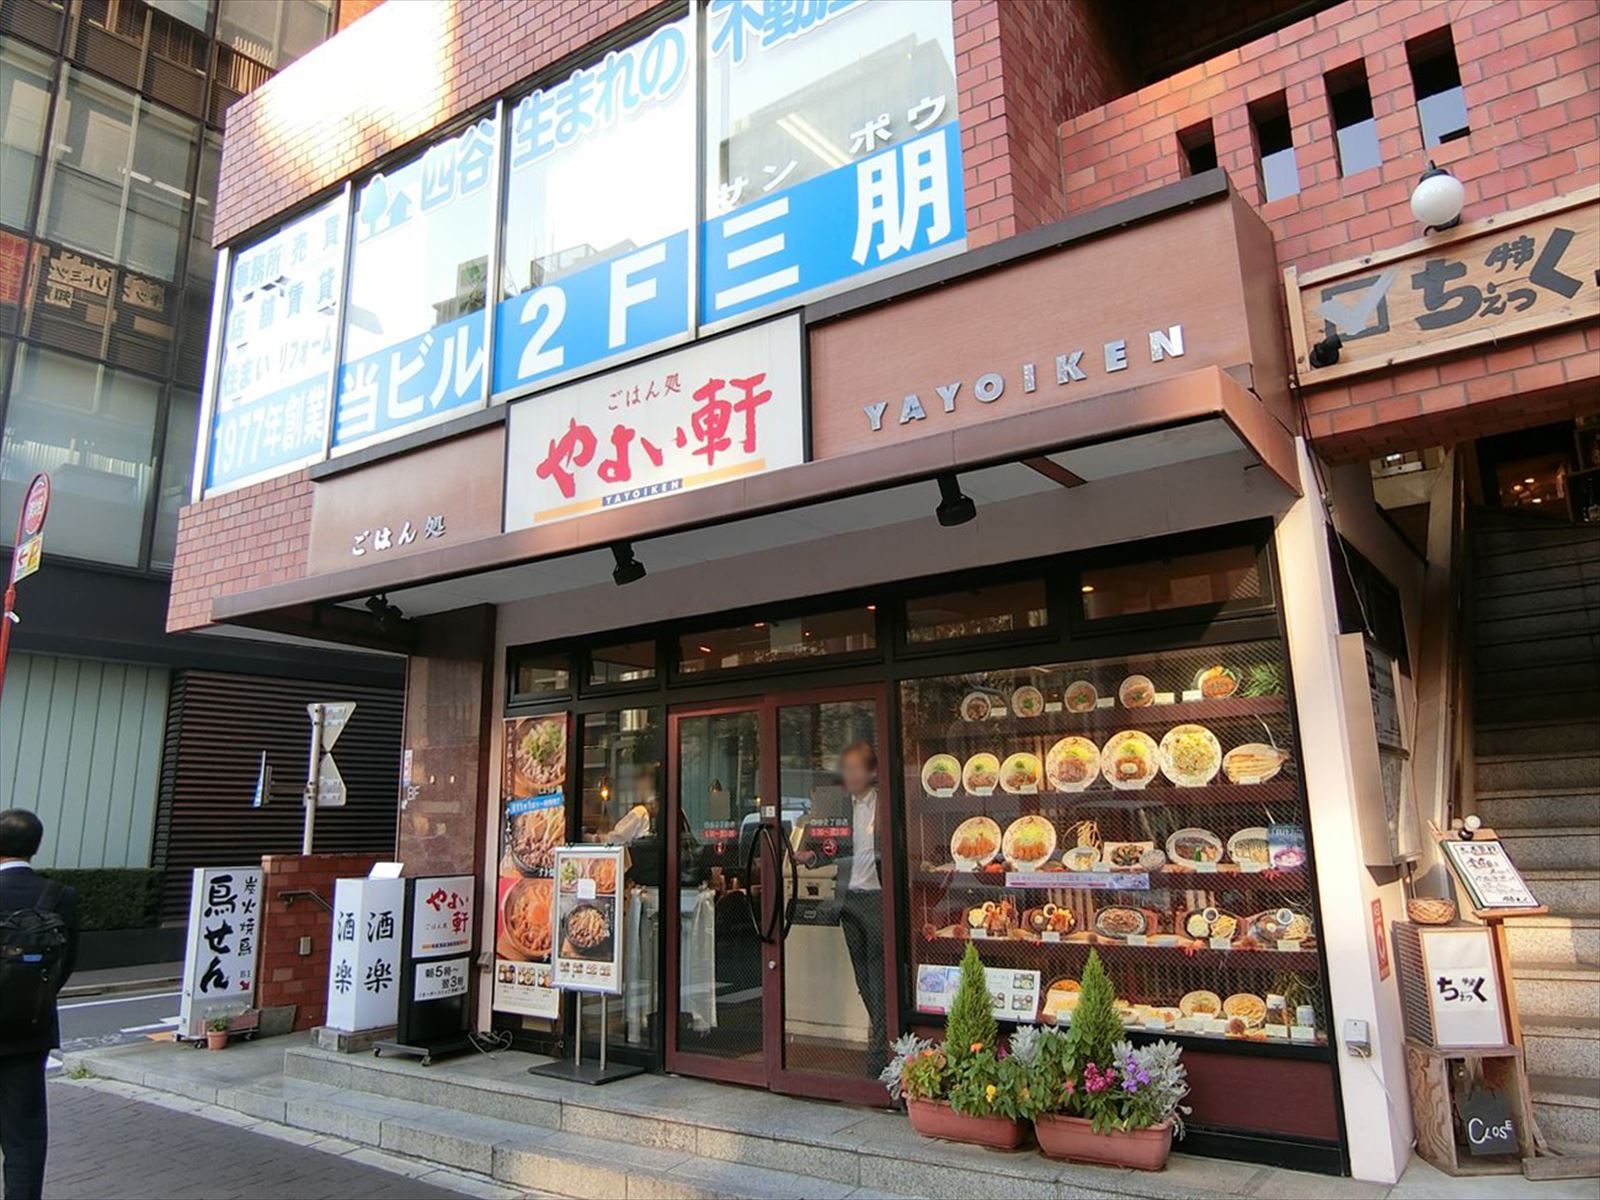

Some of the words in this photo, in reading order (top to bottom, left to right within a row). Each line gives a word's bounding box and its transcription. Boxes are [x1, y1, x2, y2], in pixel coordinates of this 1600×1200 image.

[336, 324, 485, 440] 当ビル
[606, 372, 682, 411] ごはん処
[862, 324, 1186, 431] YAYOIKEN
[212, 377, 327, 476] 1977年創業
[535, 372, 774, 500] やよい軒
[351, 514, 448, 557] ごはん処
[605, 480, 681, 505] YAYOIKEN
[333, 911, 356, 996] 酒楽
[364, 909, 396, 995] 酒楽
